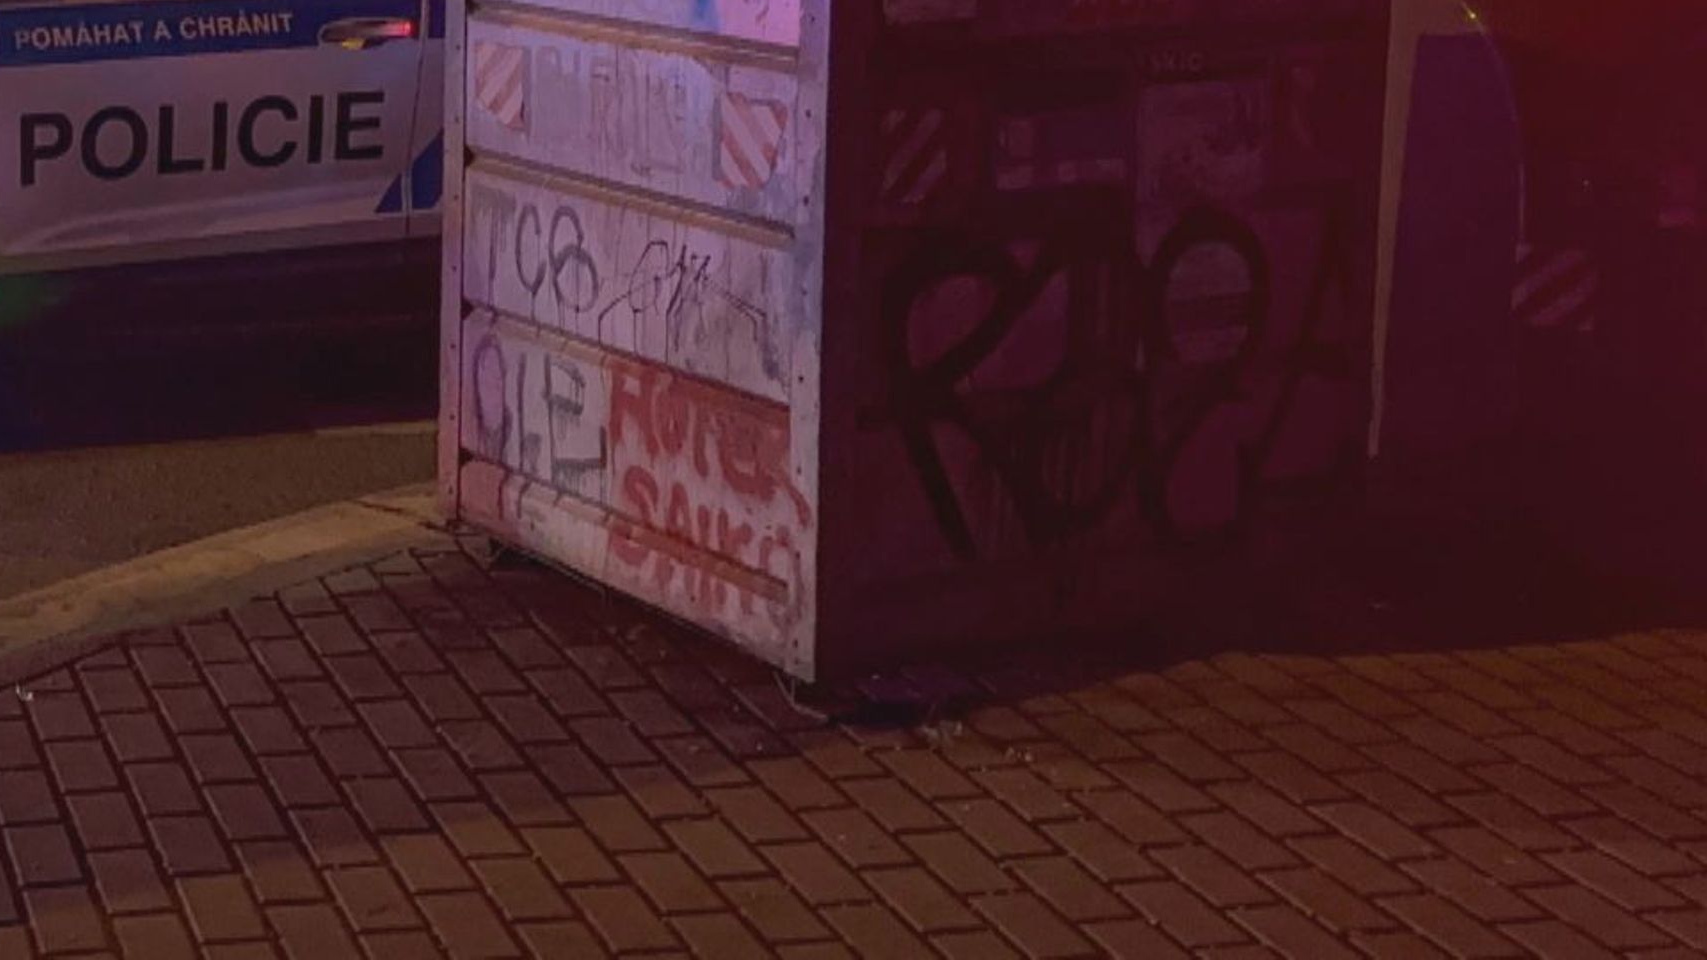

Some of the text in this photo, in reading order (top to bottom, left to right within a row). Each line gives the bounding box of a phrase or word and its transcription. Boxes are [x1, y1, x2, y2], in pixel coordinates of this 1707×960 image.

[14, 10, 294, 51] POMÁHAT A CHRÁNIT
[19, 90, 385, 187] POLICIE
